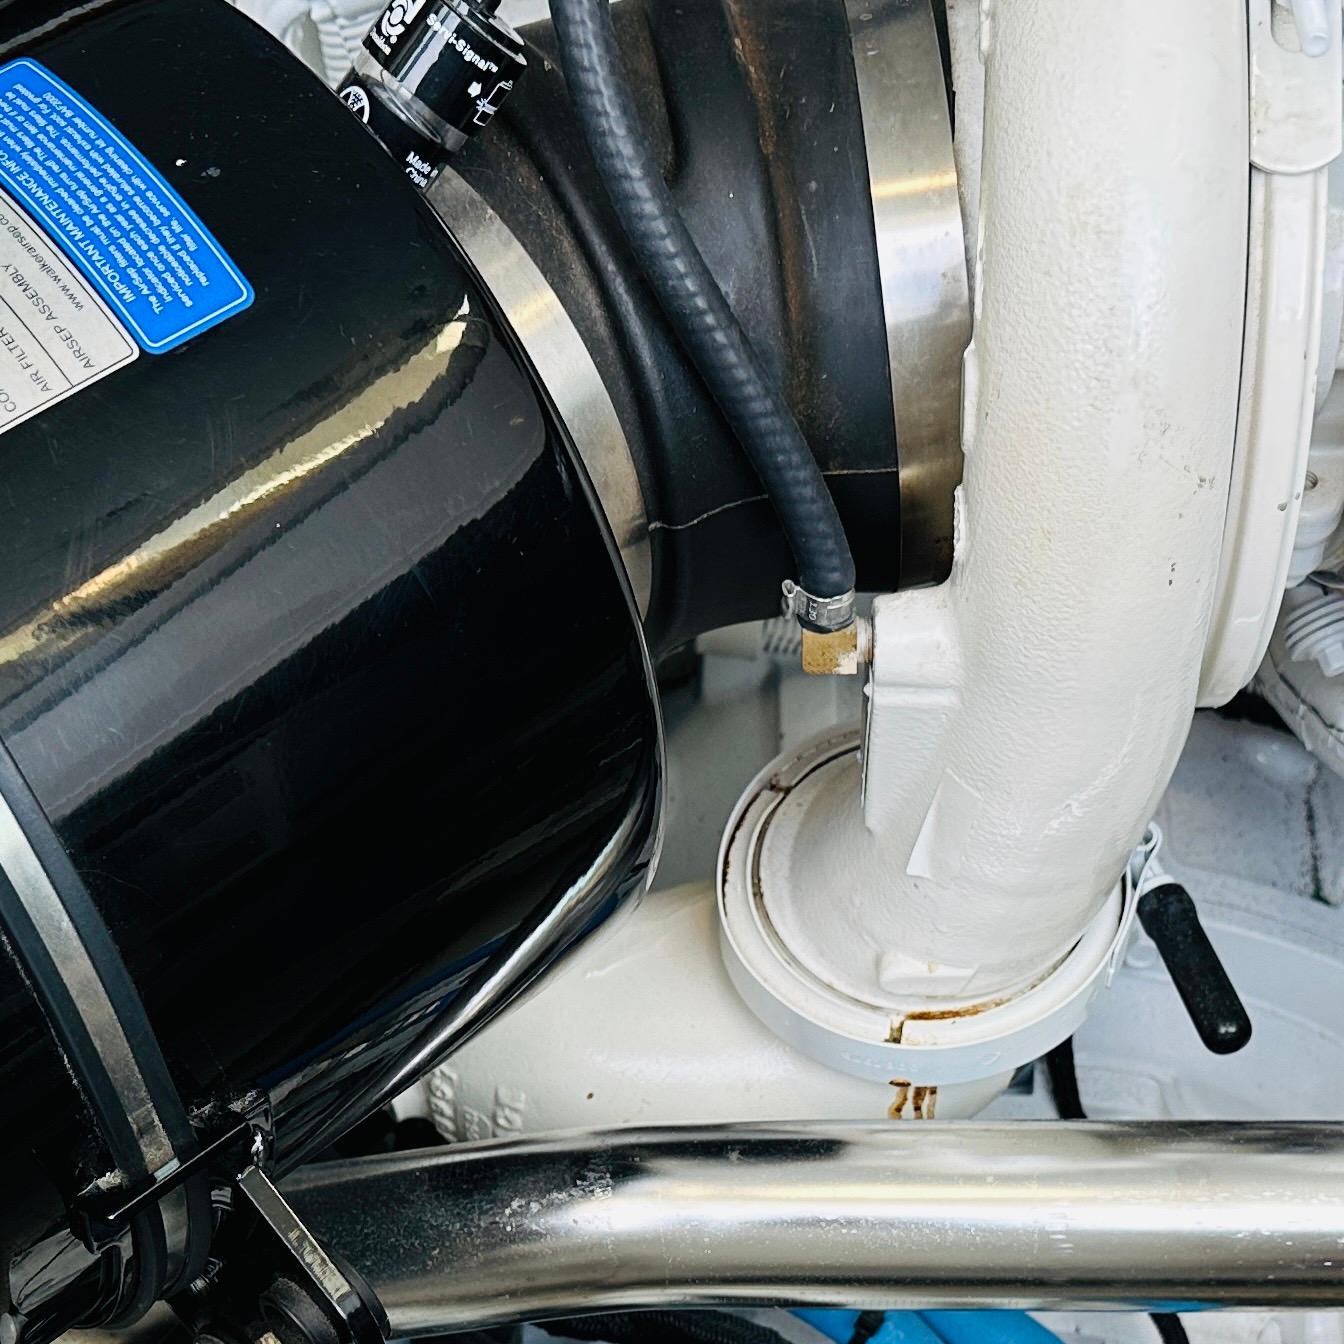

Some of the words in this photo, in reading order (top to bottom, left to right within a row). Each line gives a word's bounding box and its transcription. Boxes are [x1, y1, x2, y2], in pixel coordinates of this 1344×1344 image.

[2, 134, 22, 153] when
[32, 145, 48, 161] The
[405, 151, 433, 176] Made
[74, 169, 104, 197] general
[15, 170, 85, 241] MAINTENANCE
[54, 185, 85, 216] cleaned
[74, 189, 100, 214] AirSep
[104, 201, 118, 214] as
[118, 199, 131, 211] in
[131, 193, 162, 227] become
[144, 189, 171, 218] service
[80, 213, 94, 228] be
[96, 211, 112, 228] the
[107, 225, 122, 238] on
[113, 212, 134, 231] year
[126, 208, 161, 246] decrease
[89, 224, 111, 246] must
[128, 229, 149, 252] each
[106, 243, 129, 268] filters
[116, 235, 145, 268] located
[145, 249, 166, 272] once
[77, 236, 137, 303] IMPORTANT
[156, 243, 194, 287] noticeable
[176, 249, 212, 287] replaced
[0, 261, 59, 323] ASSEMBLY
[125, 267, 152, 295] AirSep
[140, 265, 173, 303] indicator
[160, 270, 193, 308] serviced
[146, 293, 164, 315] The
[51, 322, 96, 369] AIRSEP
[28, 369, 54, 394] AIR
